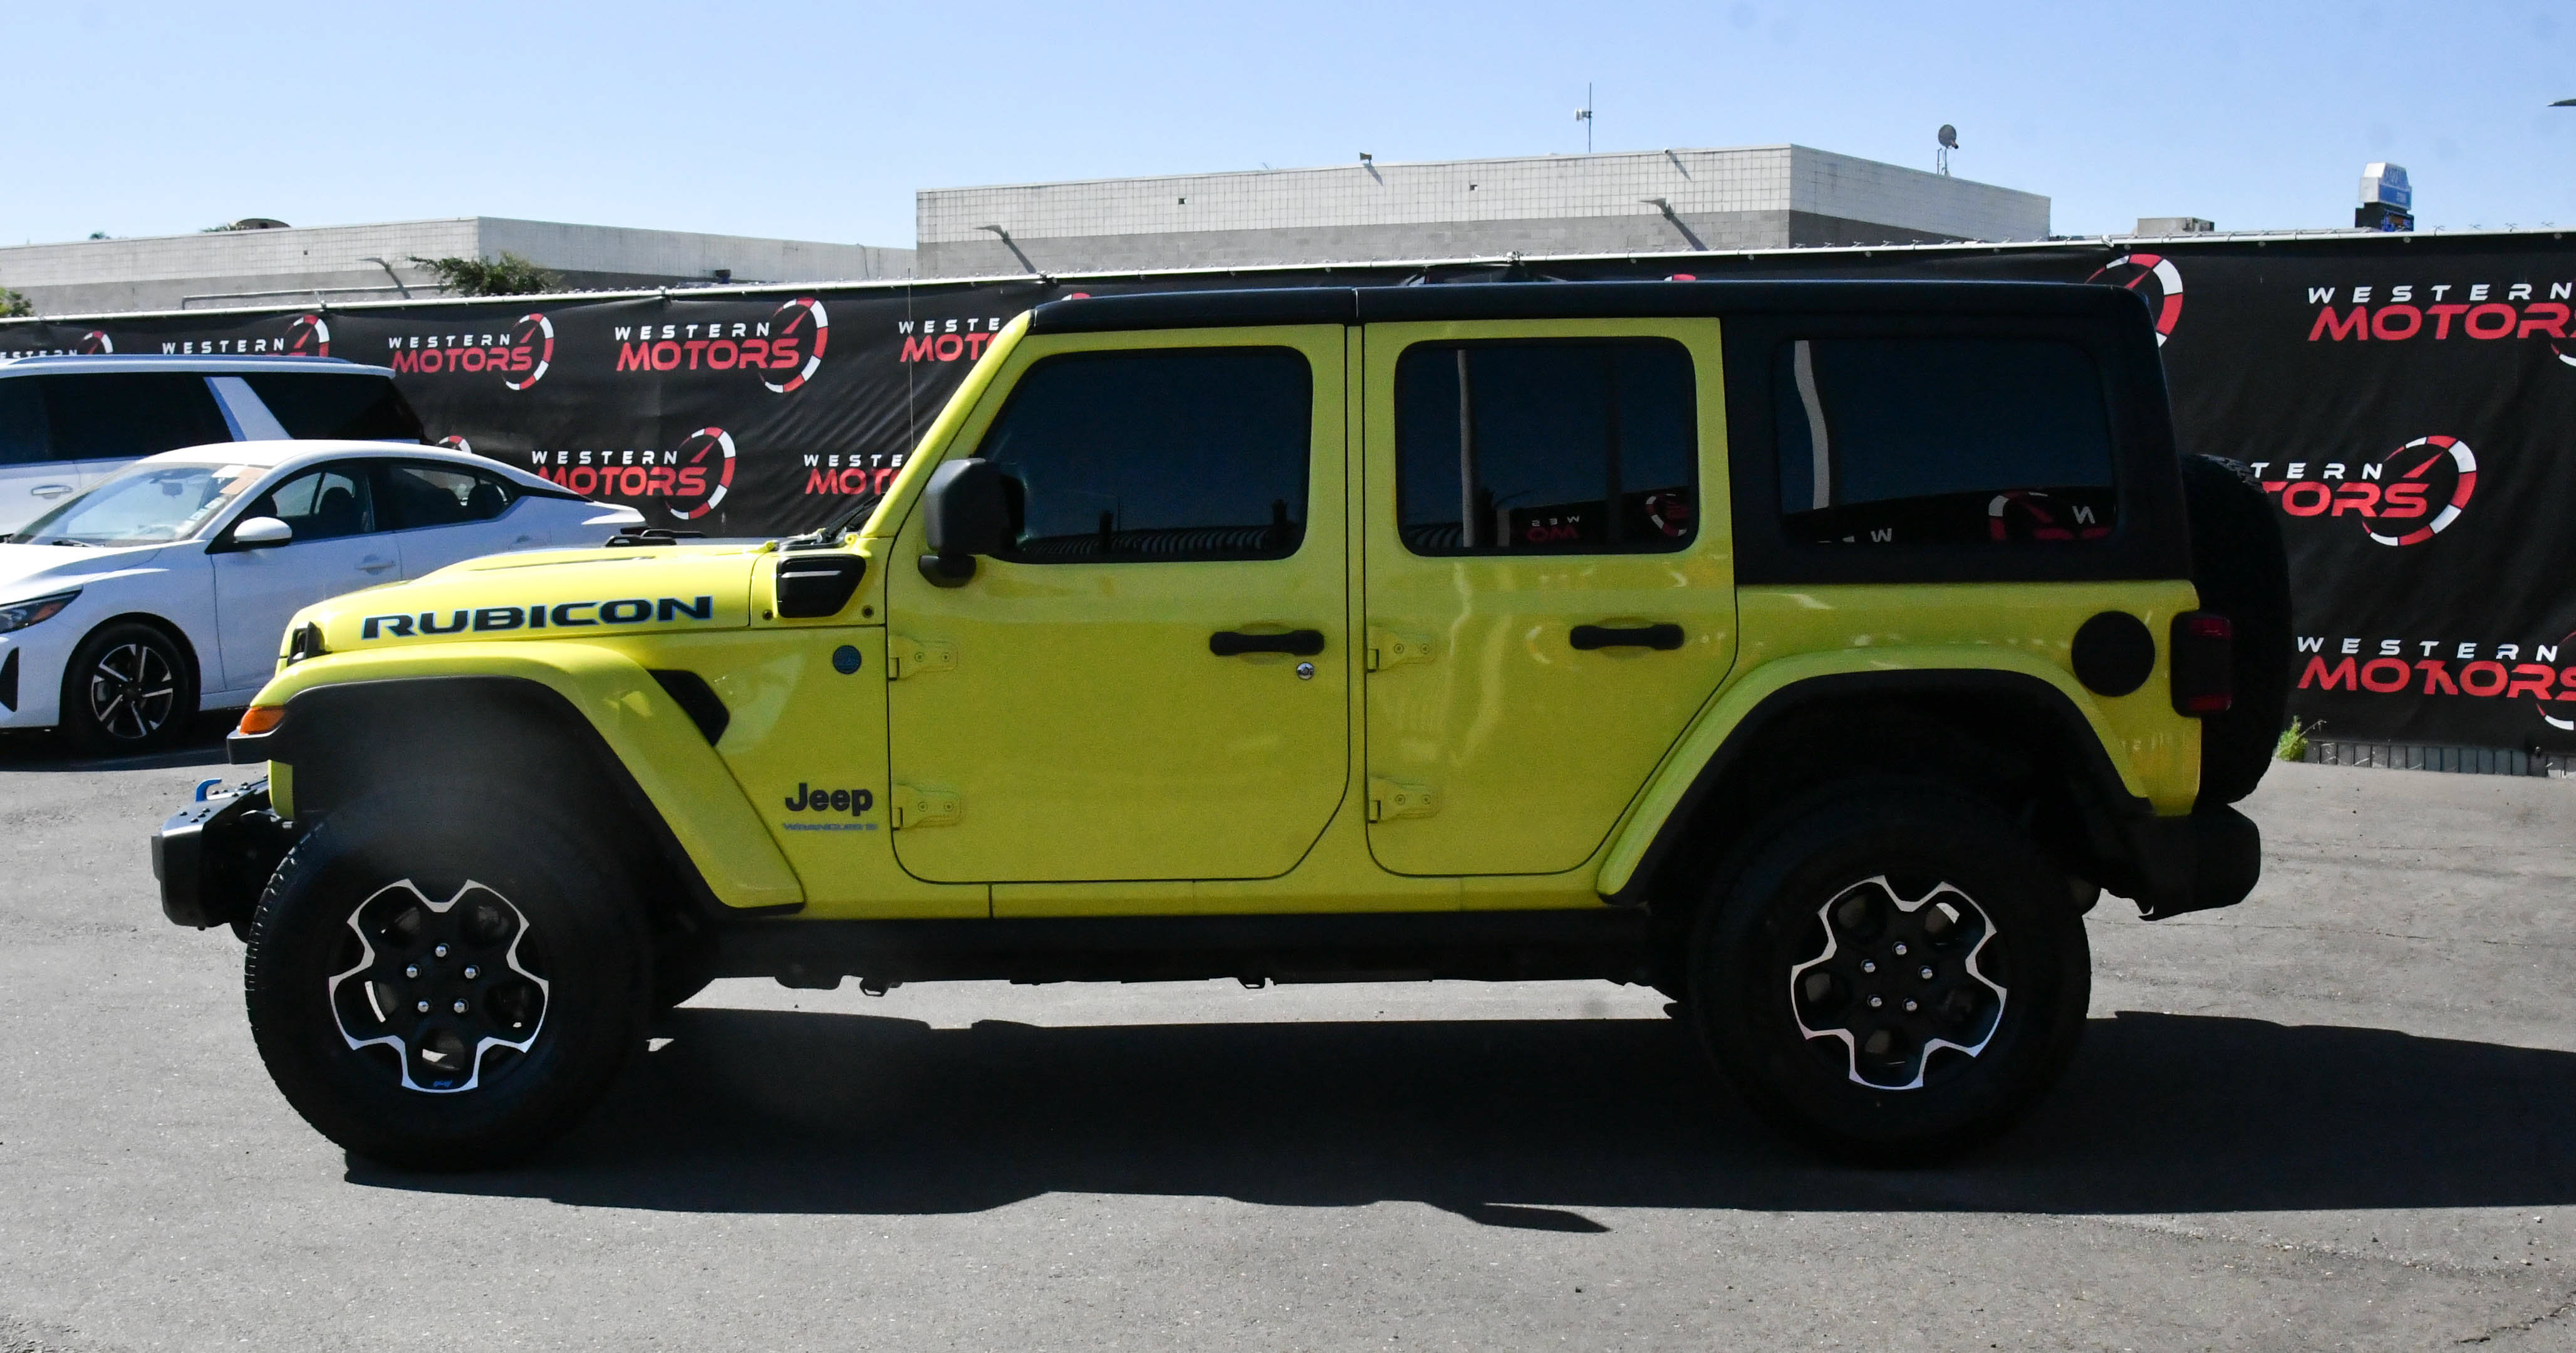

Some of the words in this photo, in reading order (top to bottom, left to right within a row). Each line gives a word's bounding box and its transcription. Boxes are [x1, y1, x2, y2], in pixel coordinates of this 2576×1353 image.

[2309, 282, 2573, 304] WESTERN
[614, 322, 770, 340] WESTERN
[898, 317, 1000, 334] WESTE
[2308, 302, 2576, 342] MOTOR
[162, 338, 284, 355] WESTERN
[388, 334, 511, 349] WESTERN
[900, 332, 998, 363] MOT
[0, 349, 78, 360] ESTERN
[391, 346, 532, 374] MOTORS
[616, 338, 800, 372] MOTORS
[532, 450, 678, 465] WESTERN
[804, 454, 903, 467] WESTE
[805, 468, 901, 495] MOT
[2250, 462, 2383, 480] TERN
[361, 595, 713, 640] RUBICON
[2297, 636, 2558, 662] WESTERN
[785, 782, 873, 817] Jeep
